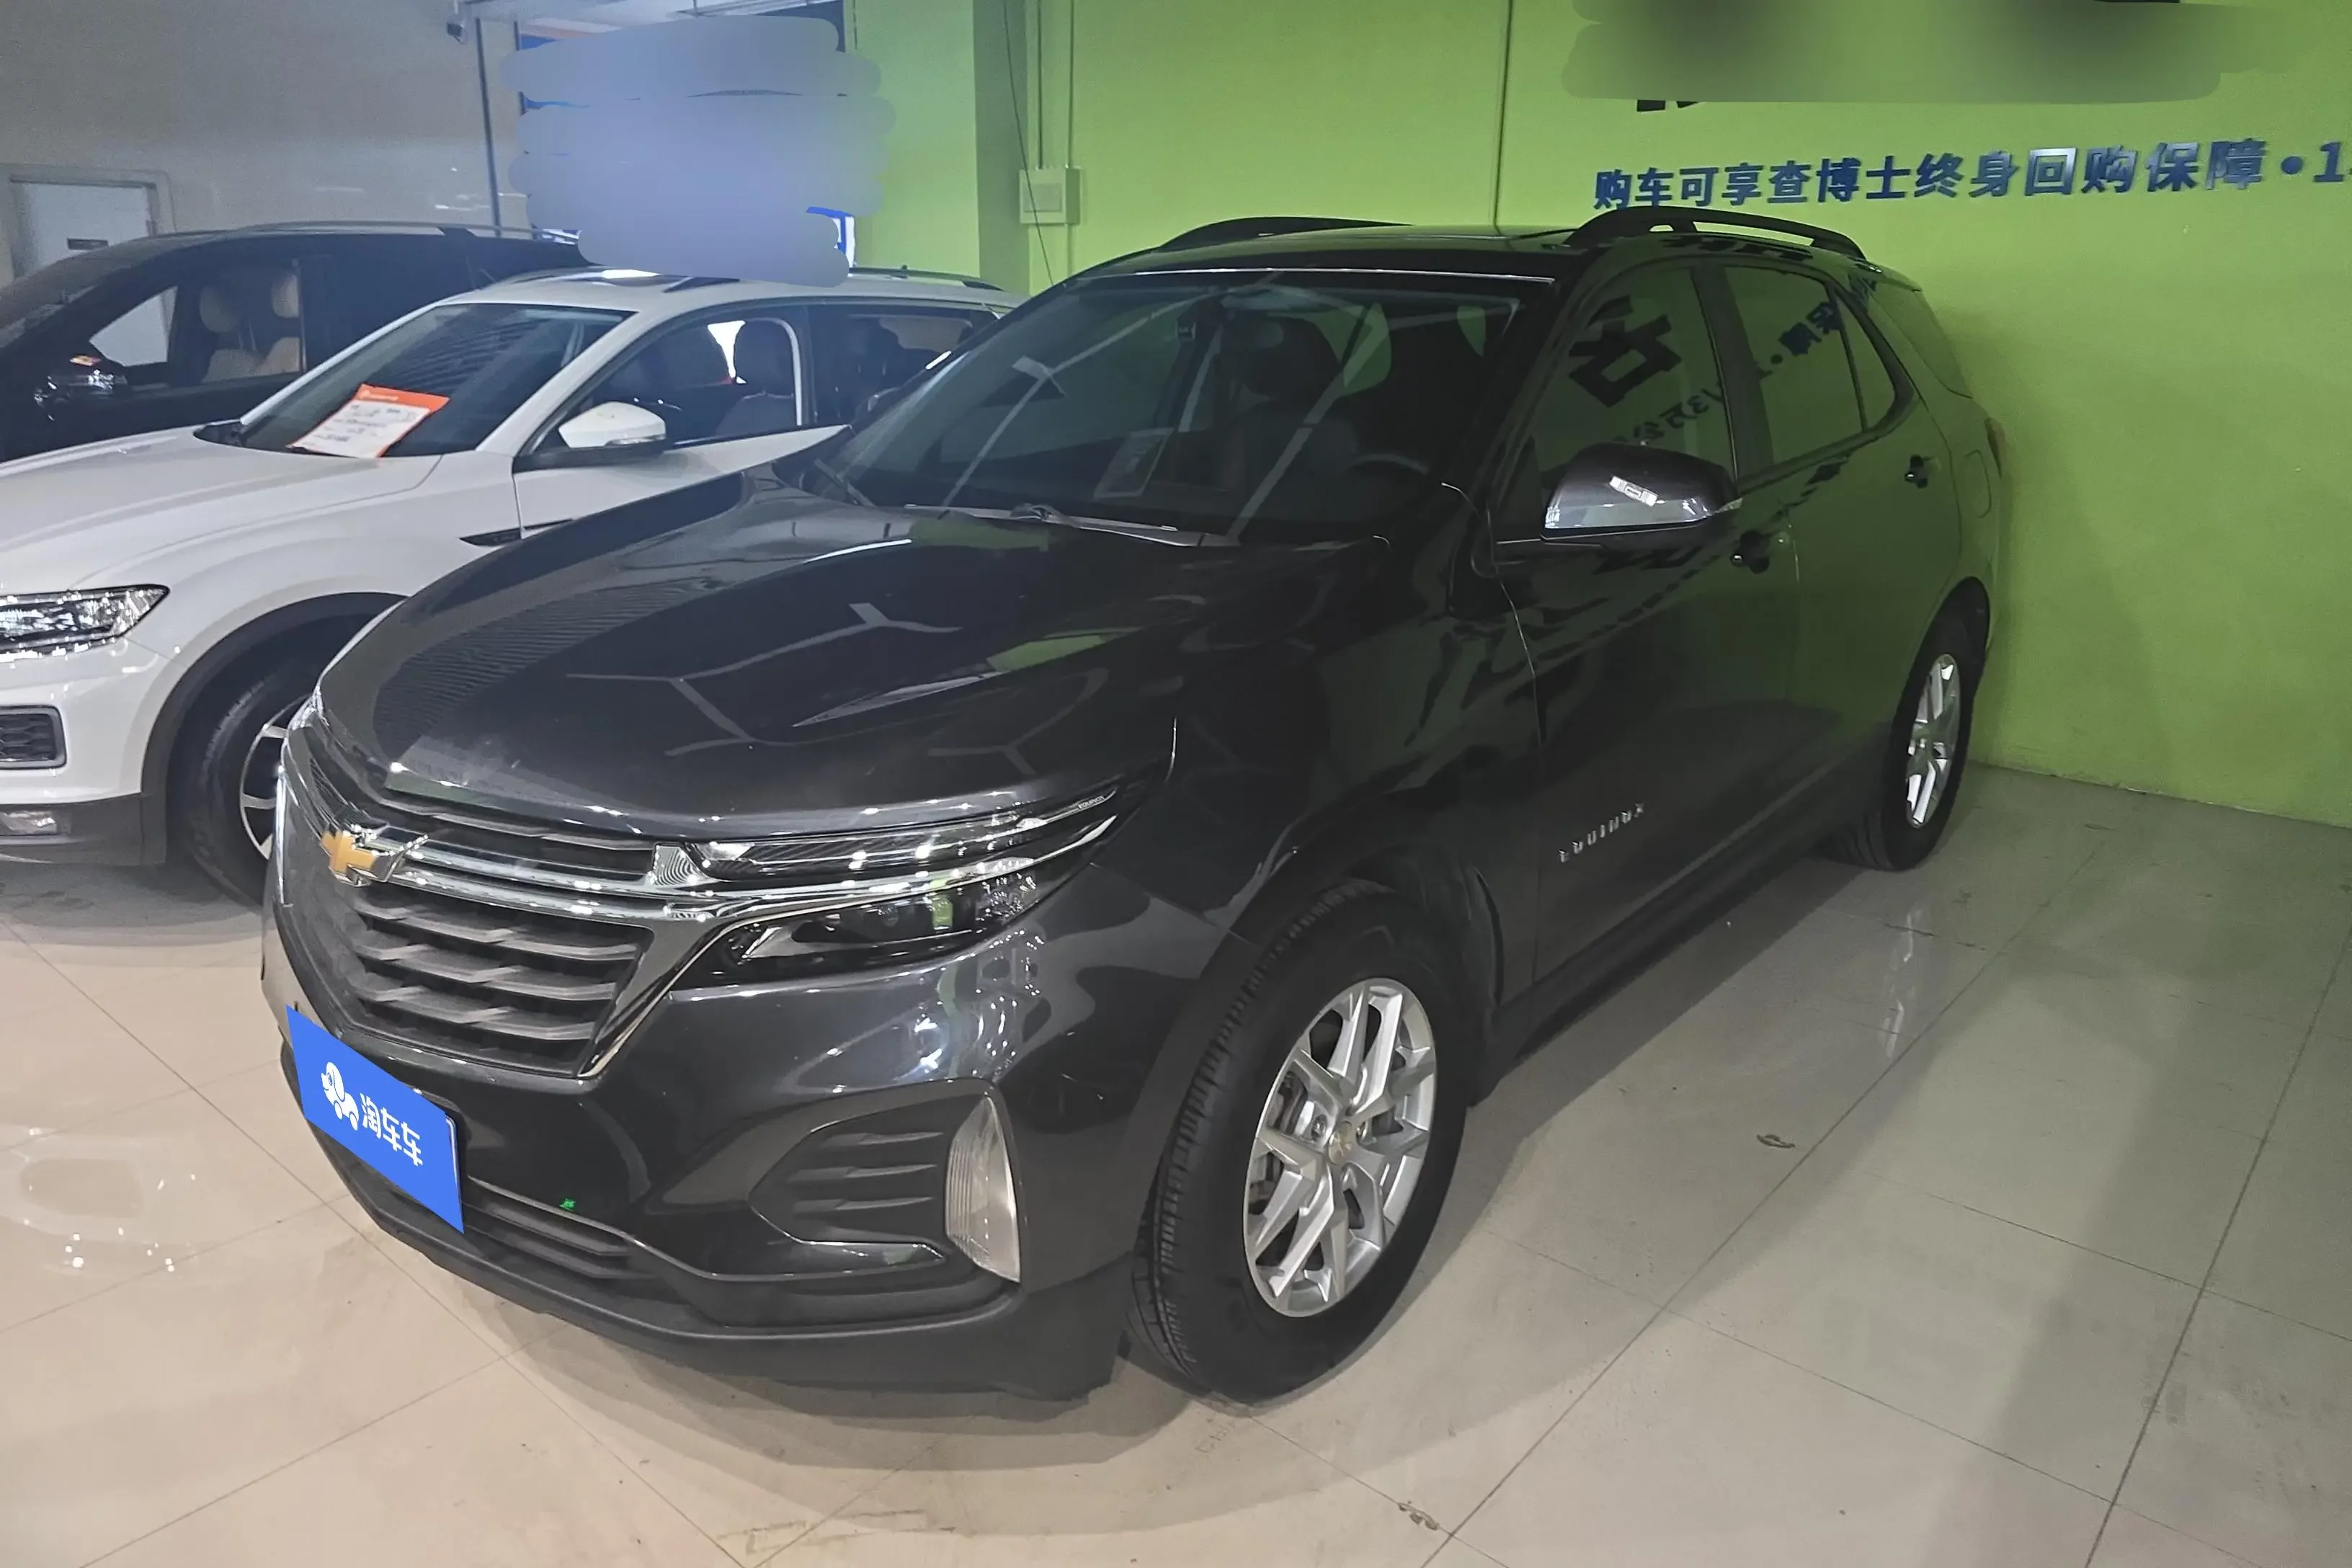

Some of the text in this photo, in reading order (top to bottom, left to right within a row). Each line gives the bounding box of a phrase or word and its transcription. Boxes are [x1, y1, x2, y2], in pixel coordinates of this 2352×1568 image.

[1593, 135, 2352, 210] 购车可享查博士终身回购保障·1
